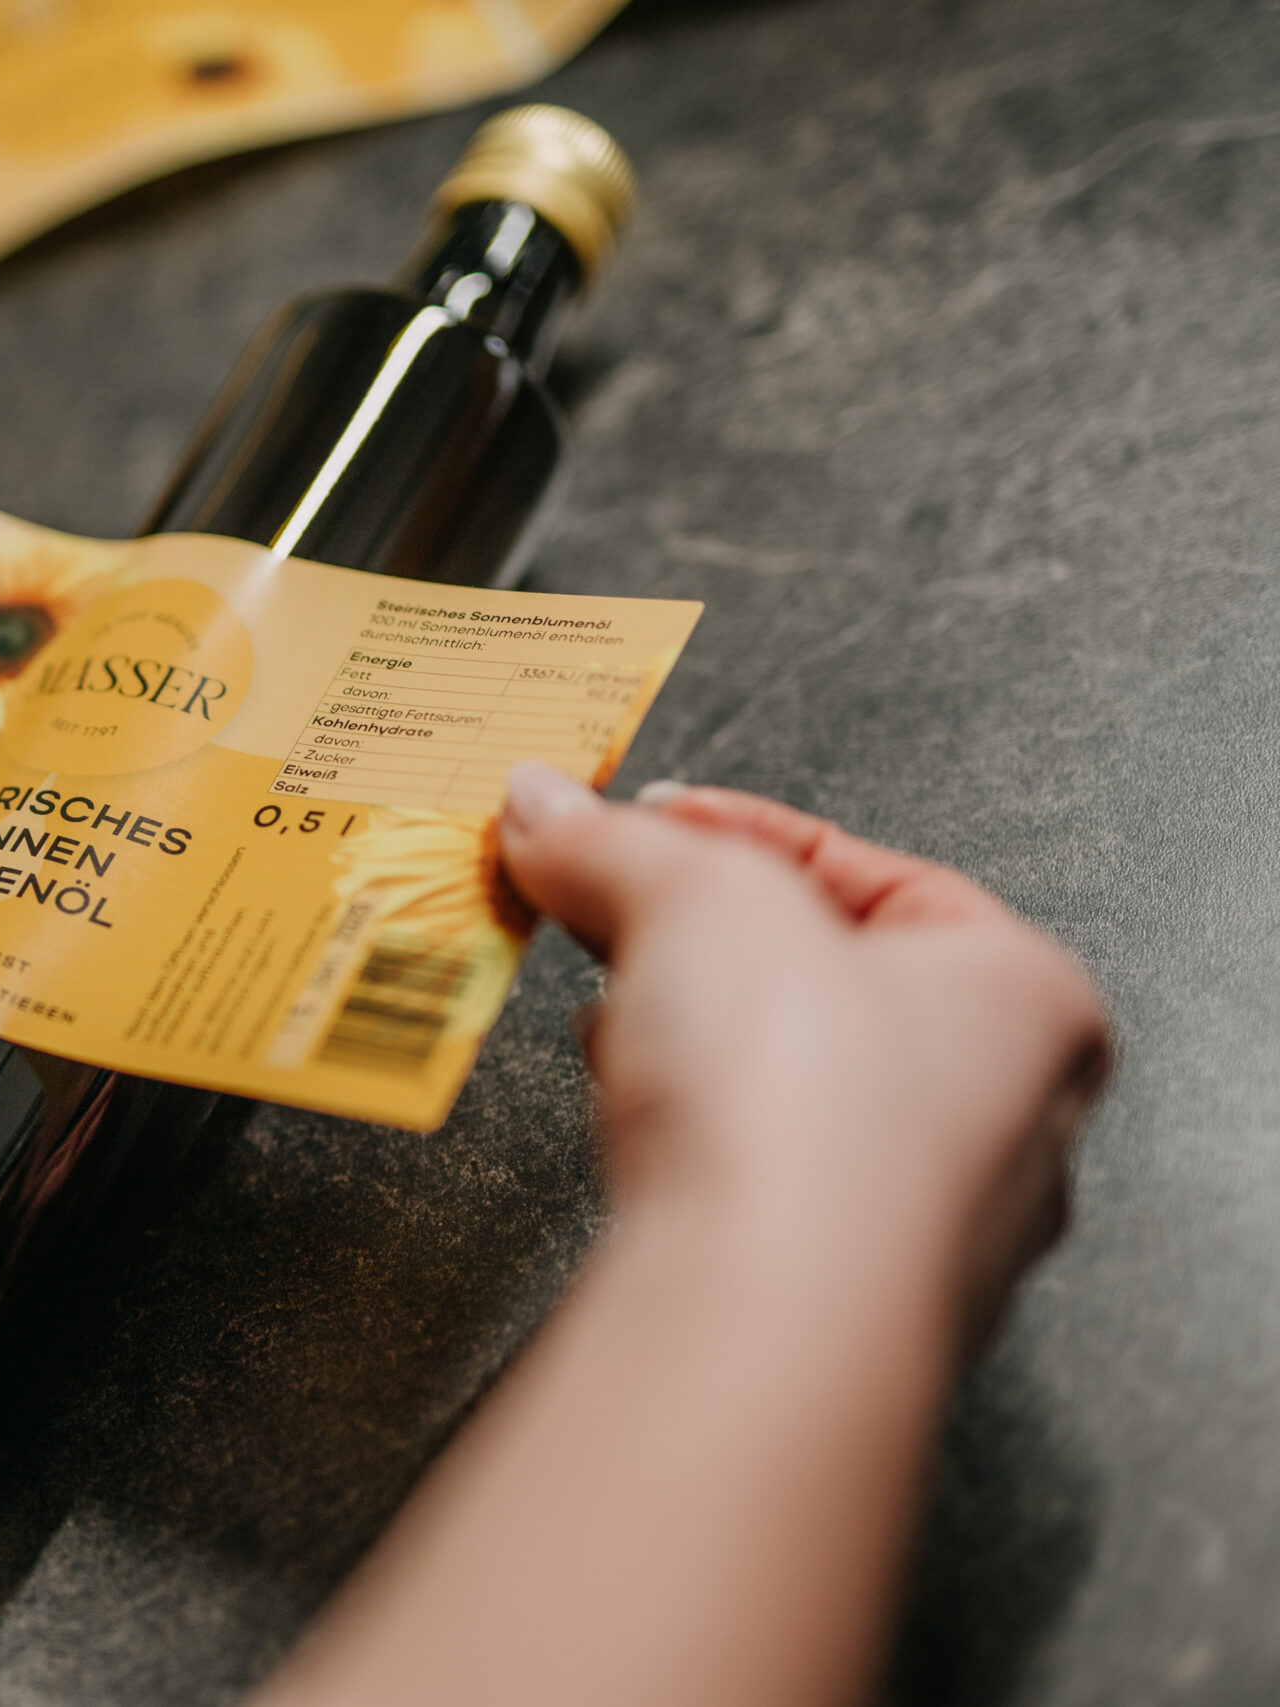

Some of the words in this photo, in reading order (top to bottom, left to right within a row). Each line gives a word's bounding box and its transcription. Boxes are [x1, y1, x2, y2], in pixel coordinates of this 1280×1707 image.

[376, 600, 466, 621] Steirisches
[470, 611, 613, 631] Sonnenblumenöl
[370, 614, 395, 628] 100
[398, 618, 417, 631] ml
[420, 620, 548, 641] Sonnenblumenöl
[549, 632, 625, 646] enthalten
[359, 628, 487, 652] durchschnittlich:
[349, 651, 413, 670] Energie
[339, 667, 373, 681] Fett
[25, 653, 228, 722] MASSER
[342, 685, 393, 701] davon:
[330, 700, 403, 721] gesättigte
[404, 708, 484, 725] Fettsäuren
[84, 725, 119, 737] 1797
[311, 715, 434, 739] Kohlenhydrate
[314, 734, 365, 749] davon:
[303, 749, 358, 766] Zucker
[283, 764, 339, 781] Eiweiß
[273, 780, 310, 795] Salz
[253, 804, 326, 836] 0,5
